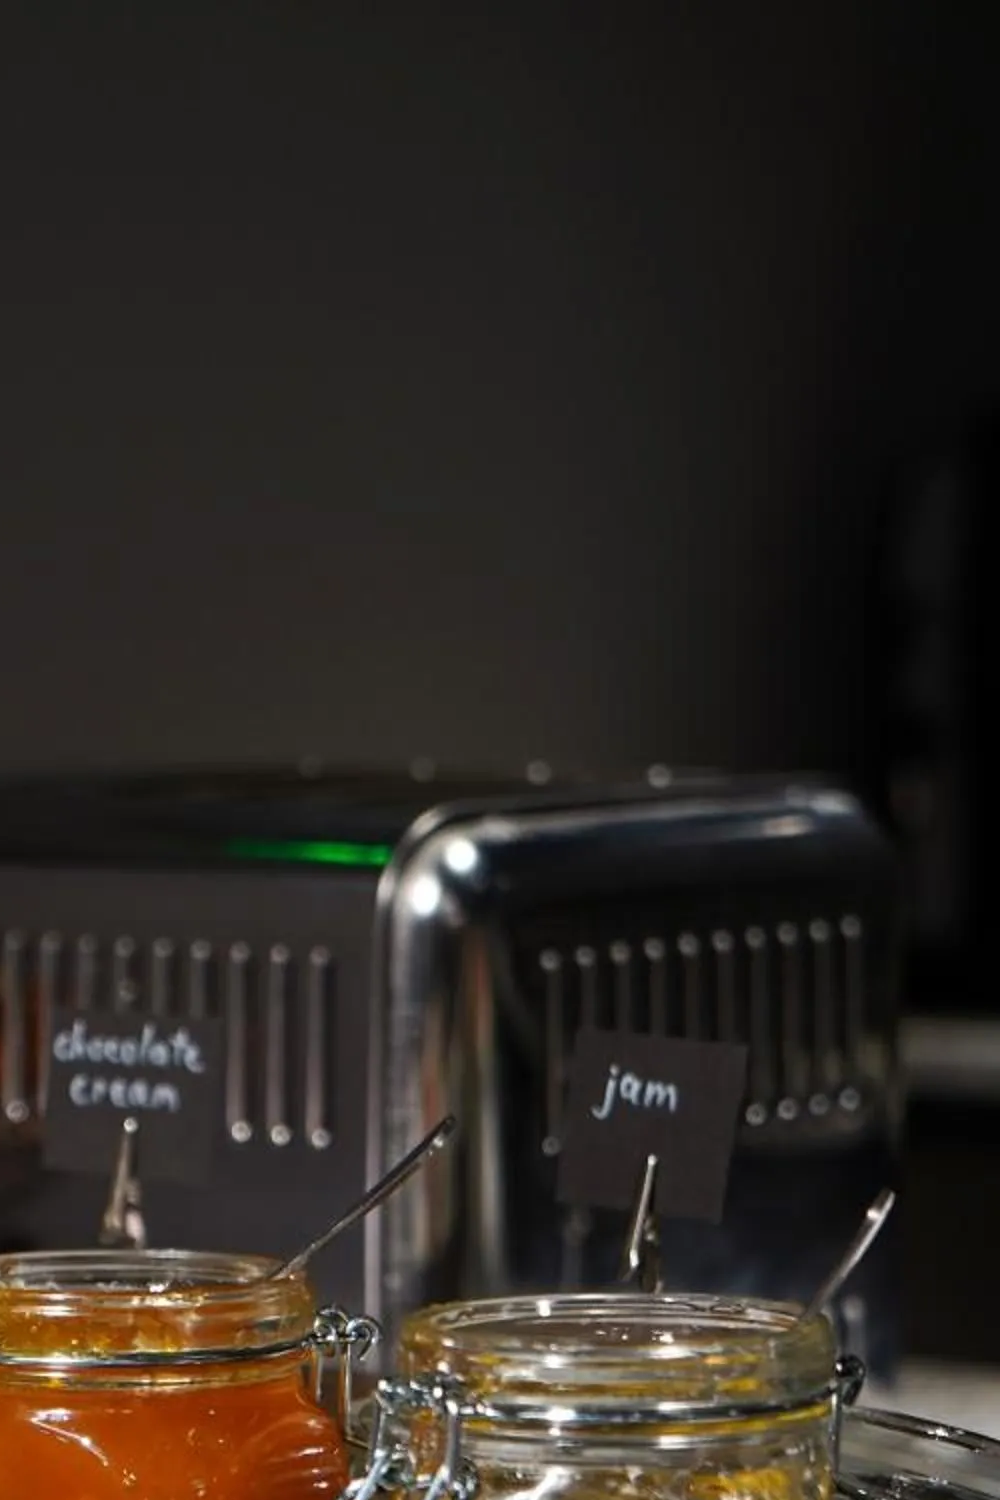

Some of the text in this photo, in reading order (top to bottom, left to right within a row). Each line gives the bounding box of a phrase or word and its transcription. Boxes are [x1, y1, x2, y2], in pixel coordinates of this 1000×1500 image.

[54, 1018, 203, 1073] chocolate
[69, 1074, 180, 1112] cream
[590, 1064, 677, 1120] jam
